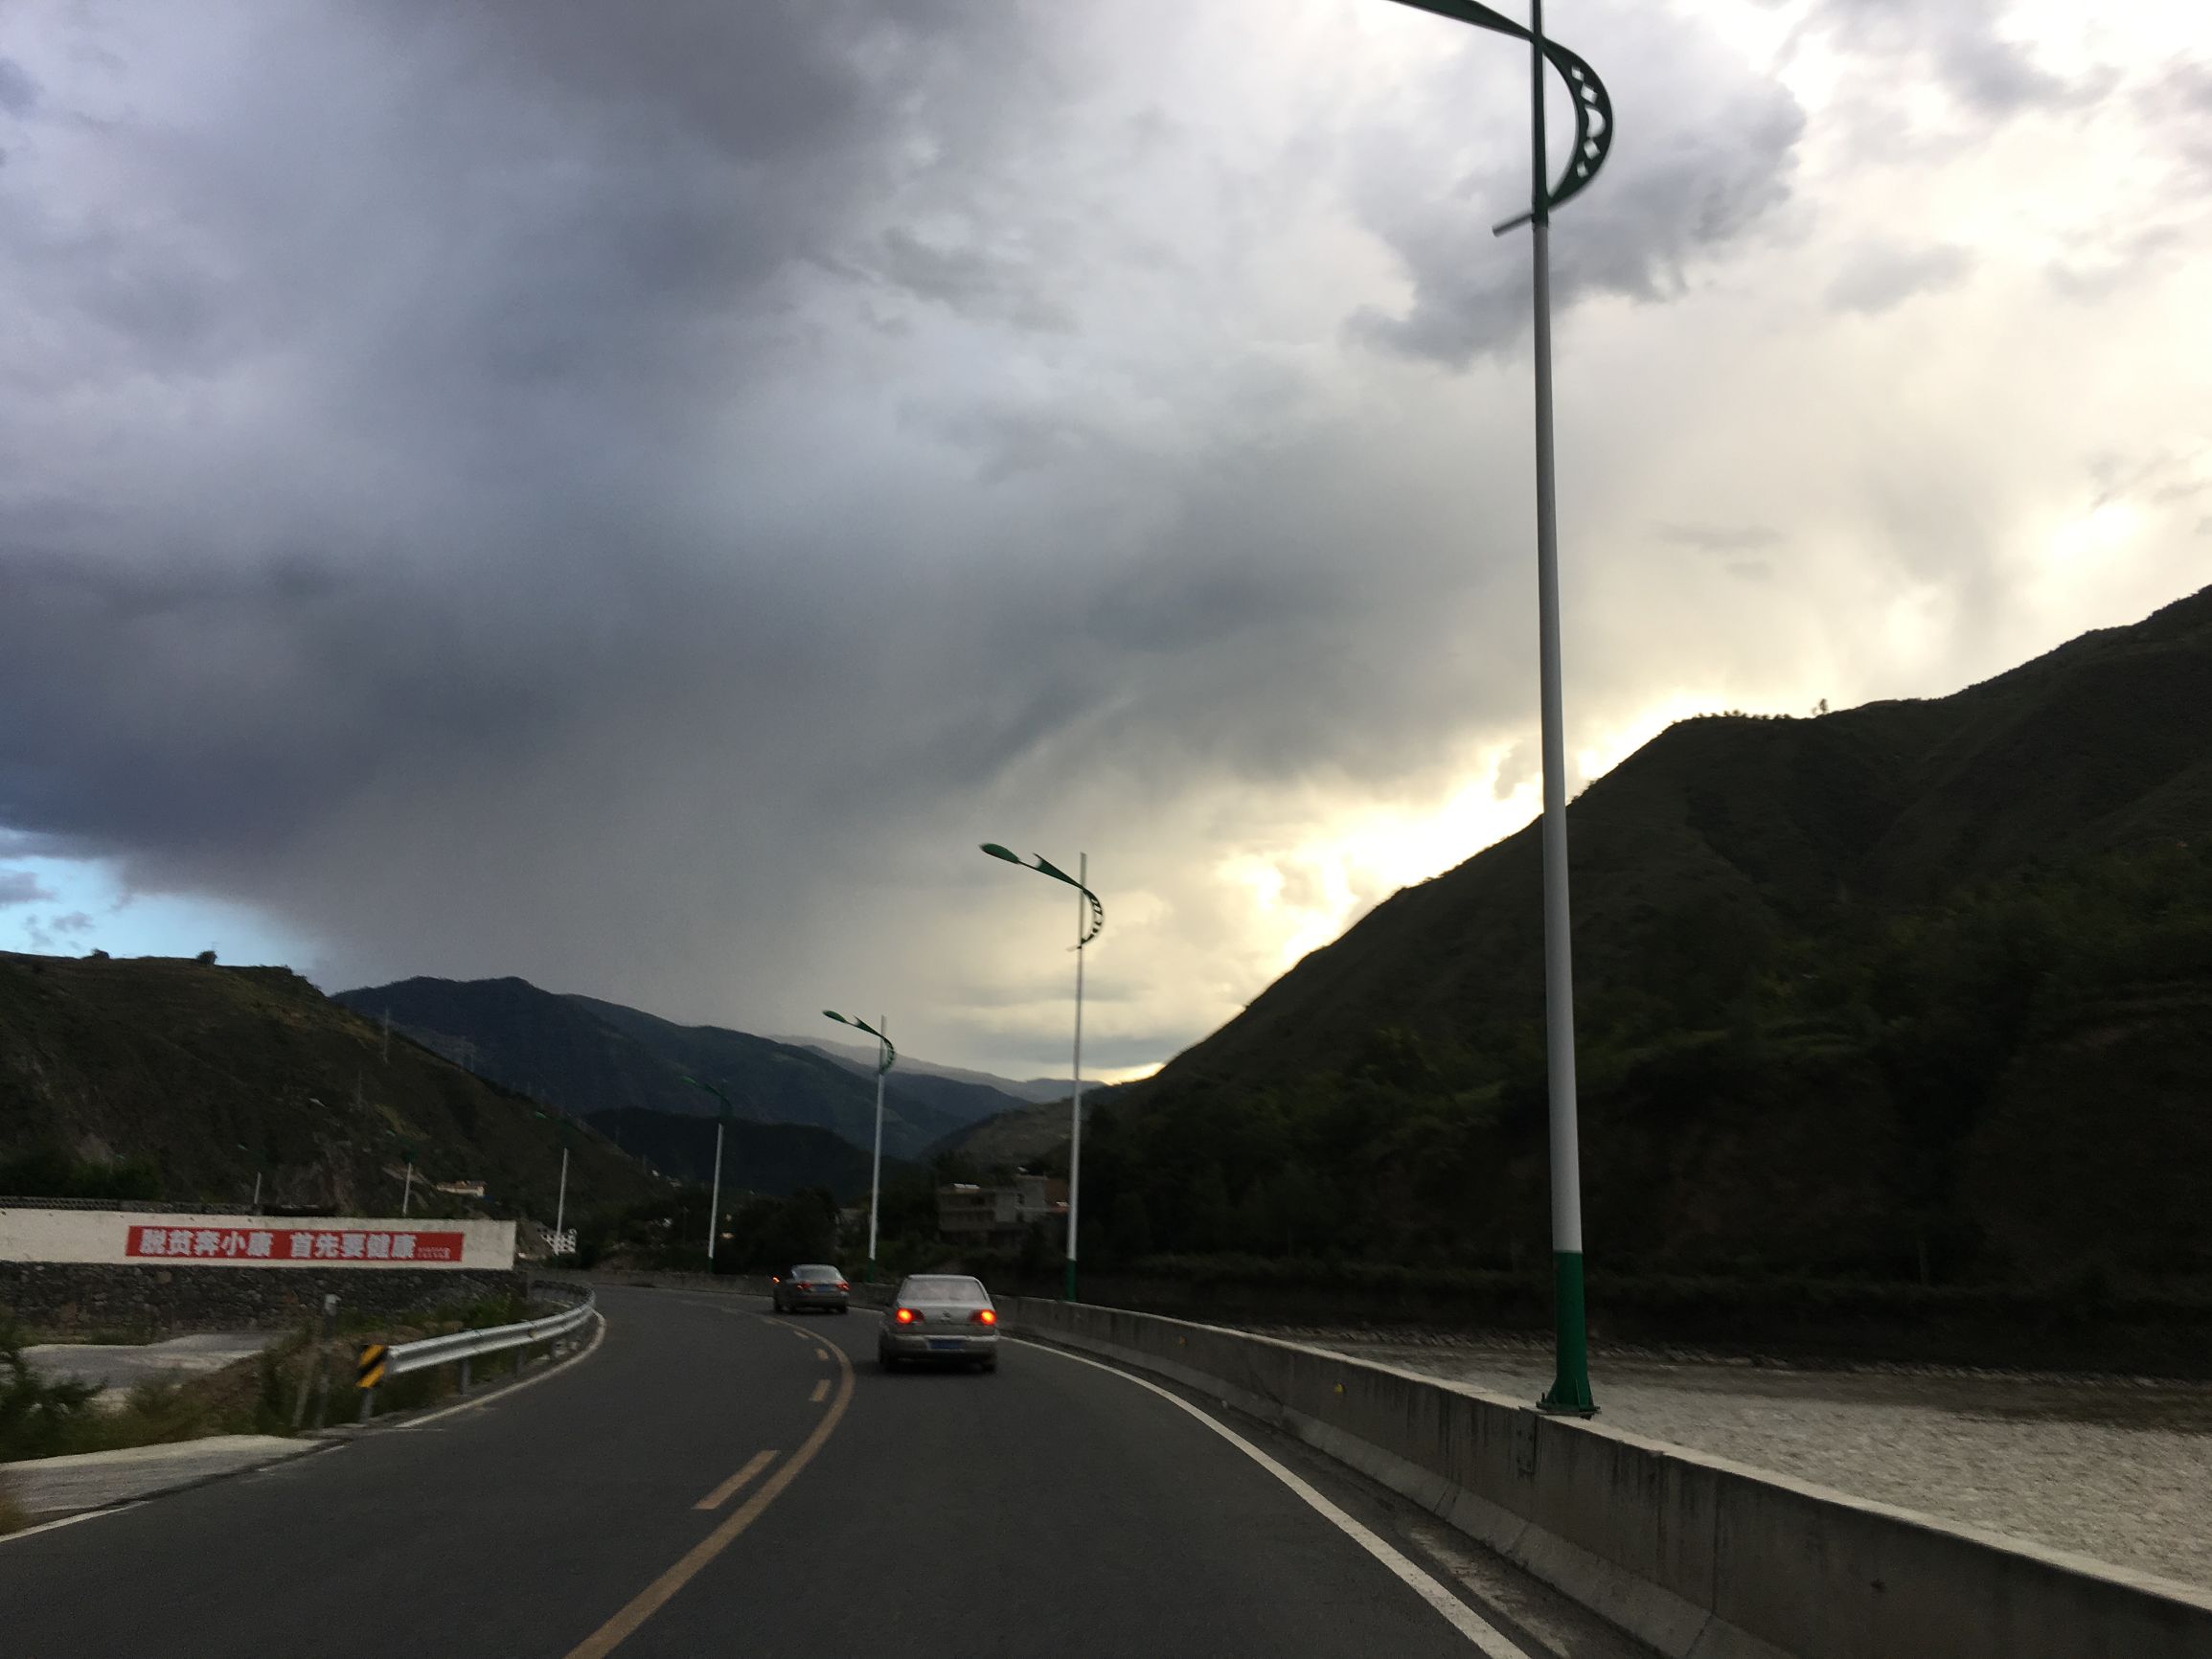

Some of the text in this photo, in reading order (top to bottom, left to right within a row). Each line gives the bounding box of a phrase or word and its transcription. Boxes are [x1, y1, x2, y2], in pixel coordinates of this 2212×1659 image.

[139, 1228, 273, 1257] 脱贫奔小康
[290, 1232, 417, 1259] 首先要健康
